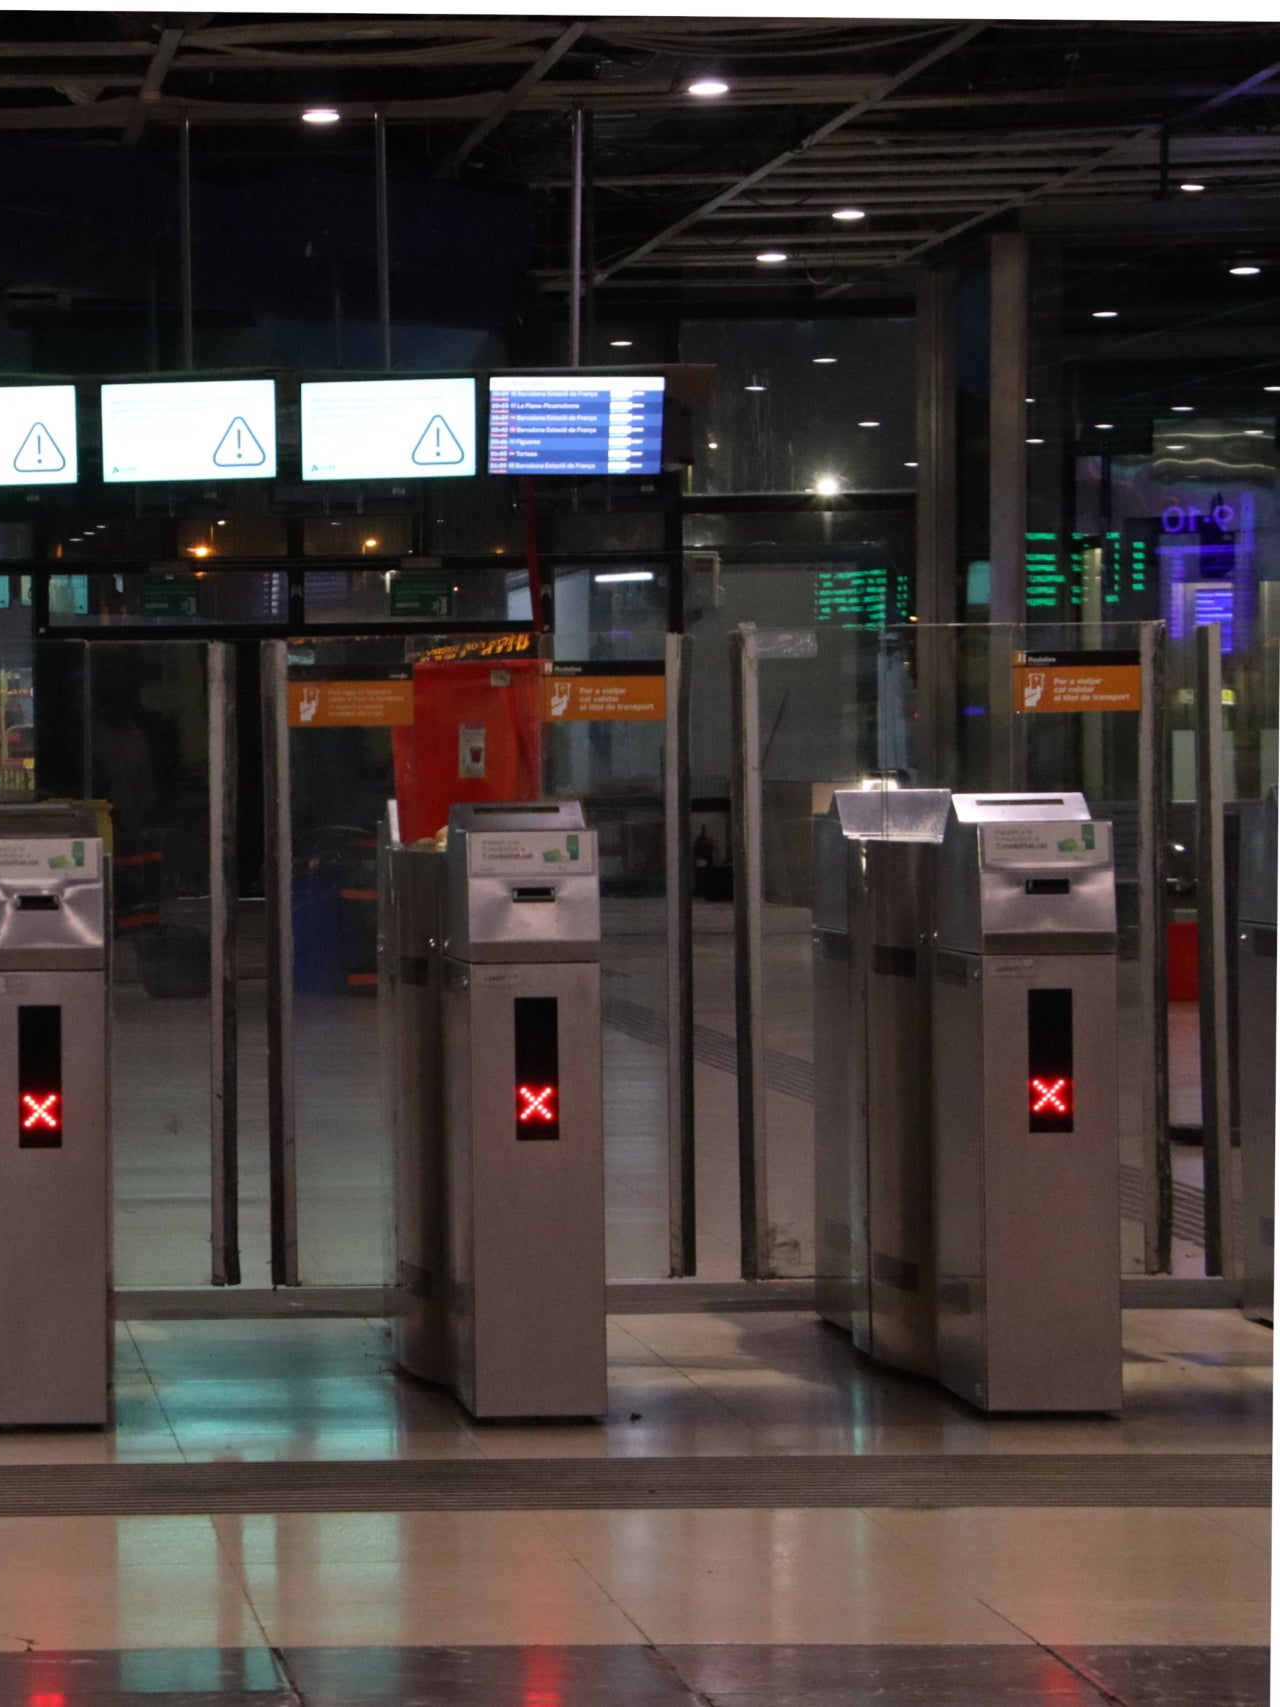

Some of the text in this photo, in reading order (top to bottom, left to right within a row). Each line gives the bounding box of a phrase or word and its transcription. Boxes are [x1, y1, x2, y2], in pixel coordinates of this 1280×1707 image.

[1077, 678, 1102, 686] viatjar
[1093, 693, 1130, 702] transport
[618, 703, 654, 712] transport
